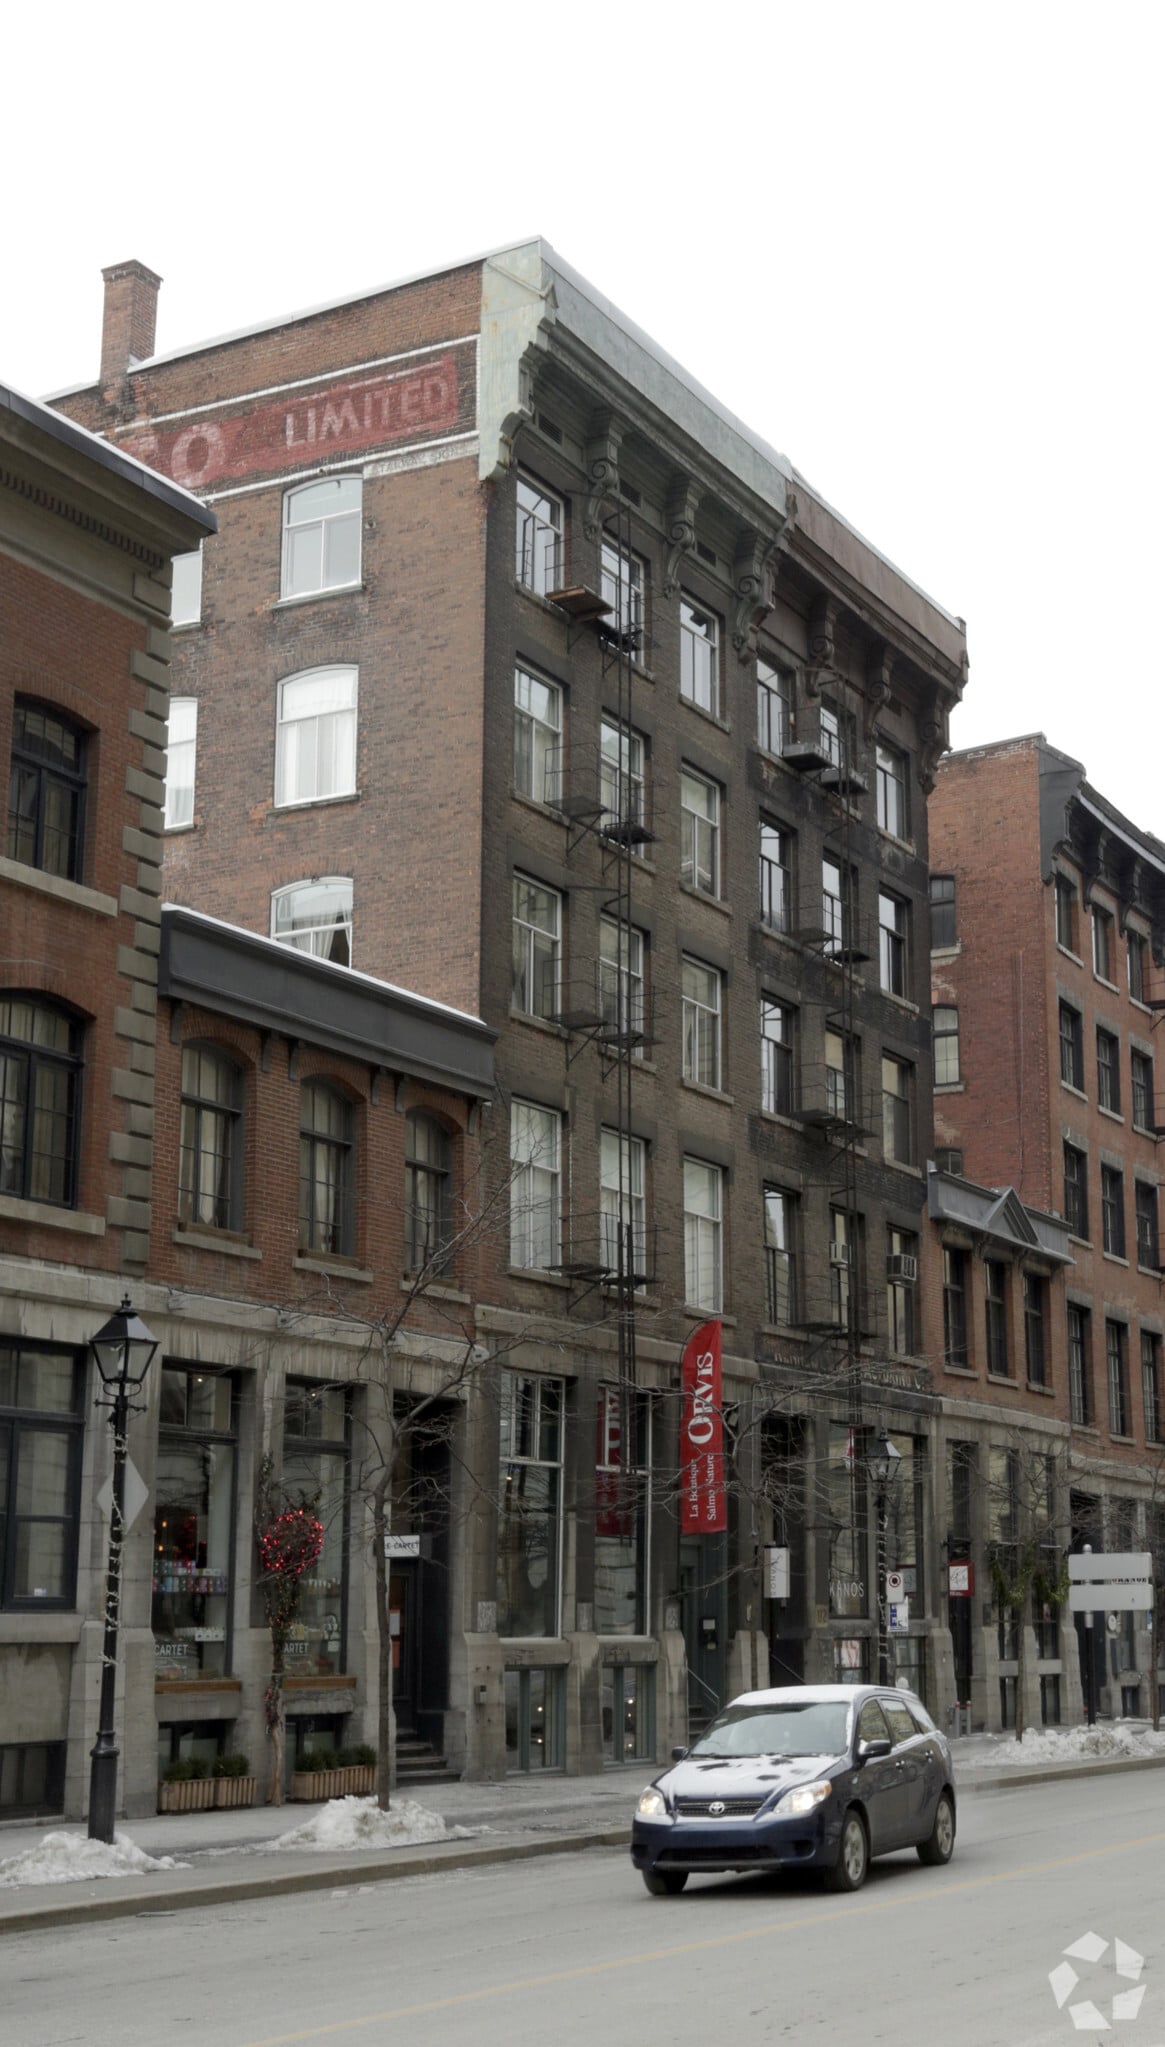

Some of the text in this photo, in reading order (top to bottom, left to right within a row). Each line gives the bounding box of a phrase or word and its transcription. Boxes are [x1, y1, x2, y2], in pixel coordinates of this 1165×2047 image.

[285, 375, 448, 450] LIMITED
[687, 1351, 714, 1444] ORVIS
[707, 1454, 716, 1486] Nature
[690, 1504, 699, 1518] La
[707, 1489, 717, 1521] Salmo
[154, 1643, 189, 1657] CARTET
[283, 1641, 310, 1655] ARTET
